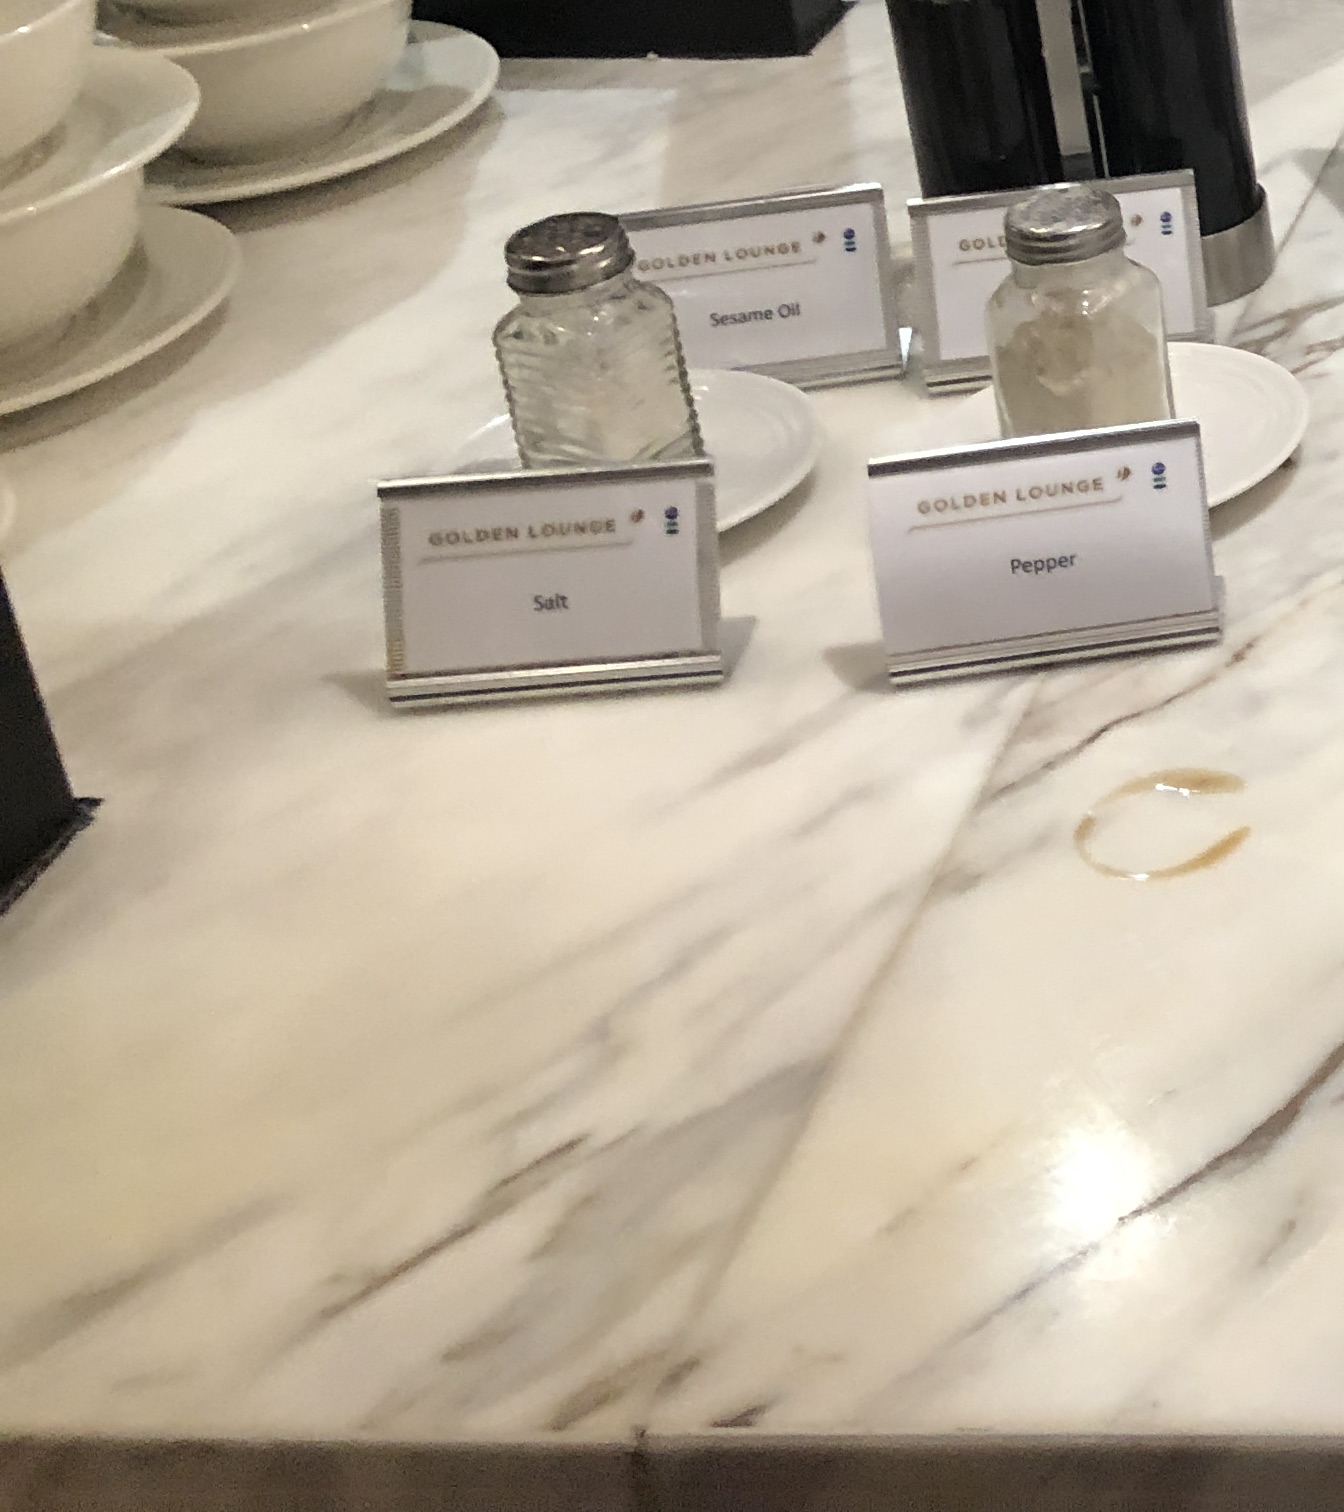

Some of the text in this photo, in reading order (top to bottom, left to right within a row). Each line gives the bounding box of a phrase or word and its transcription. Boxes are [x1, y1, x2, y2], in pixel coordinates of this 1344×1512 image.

[637, 241, 802, 272] GOLDEN LOUNGE
[709, 301, 801, 327] Sesame Oil
[916, 476, 1105, 515] GOLDEN LOUNGE
[428, 518, 617, 547] GOLDEN LOUNGE
[1010, 553, 1077, 575] Pepper
[533, 593, 570, 611] Salt
